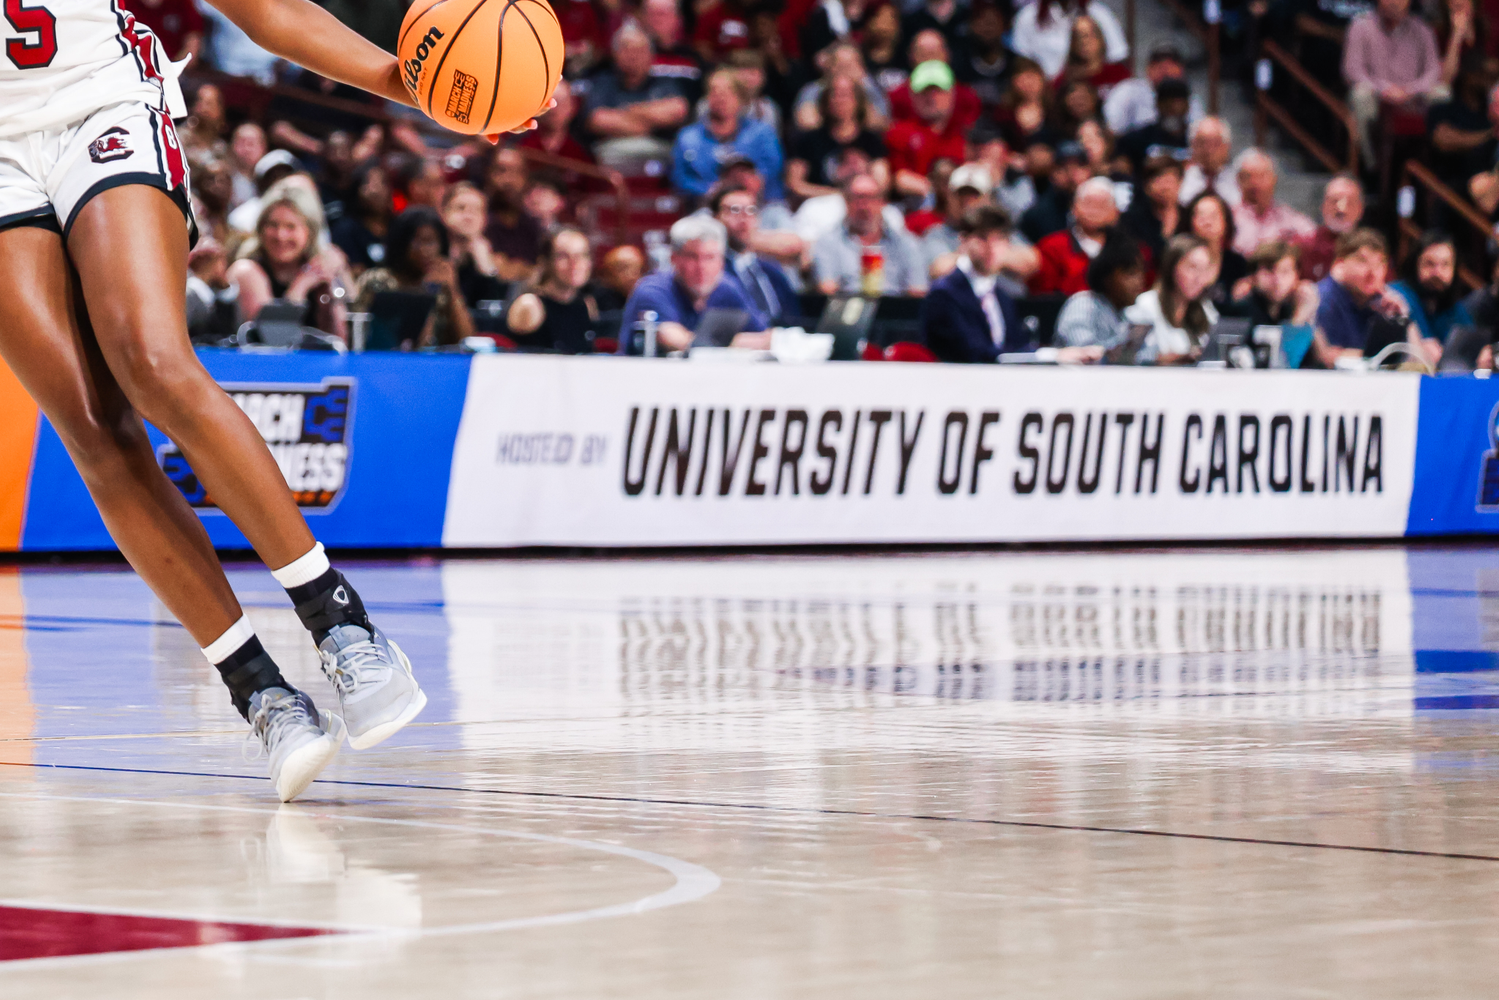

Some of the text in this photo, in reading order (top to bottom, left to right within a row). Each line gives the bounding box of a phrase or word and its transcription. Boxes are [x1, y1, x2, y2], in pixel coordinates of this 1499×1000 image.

[447, 86, 462, 112] MARCH
[457, 75, 476, 114] MADNESS
[496, 406, 1384, 497] HOSTED BY UNIVERSITY OF SOUTH CAROLINA
